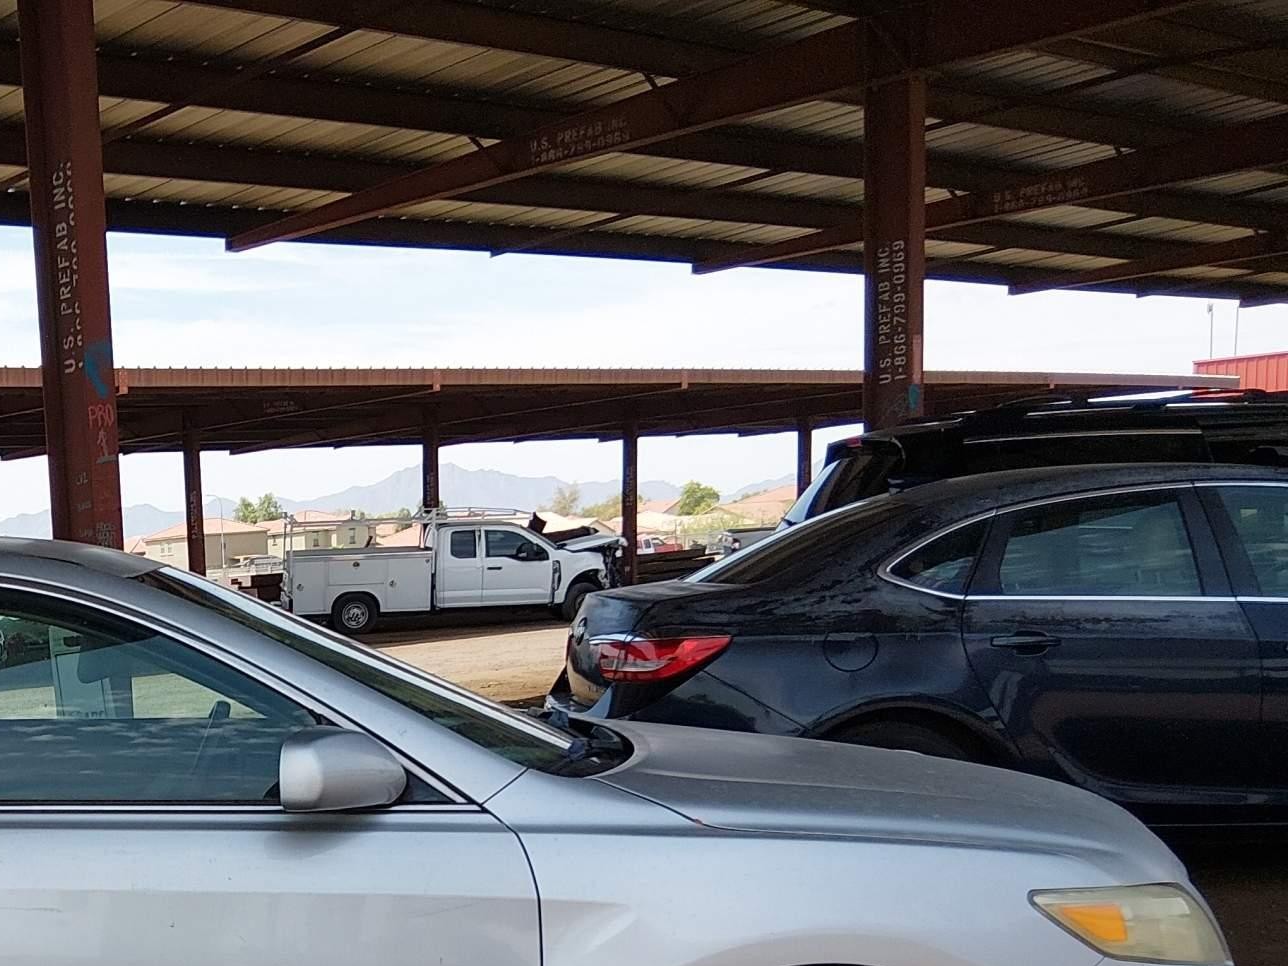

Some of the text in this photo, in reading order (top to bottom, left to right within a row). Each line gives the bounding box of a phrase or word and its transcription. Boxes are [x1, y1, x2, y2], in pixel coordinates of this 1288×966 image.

[52, 162, 66, 210] INC.
[55, 221, 73, 316] PREFAB
[878, 280, 891, 345] PREFAB
[63, 328, 76, 374] U.S.
[879, 351, 893, 385] U.S.
